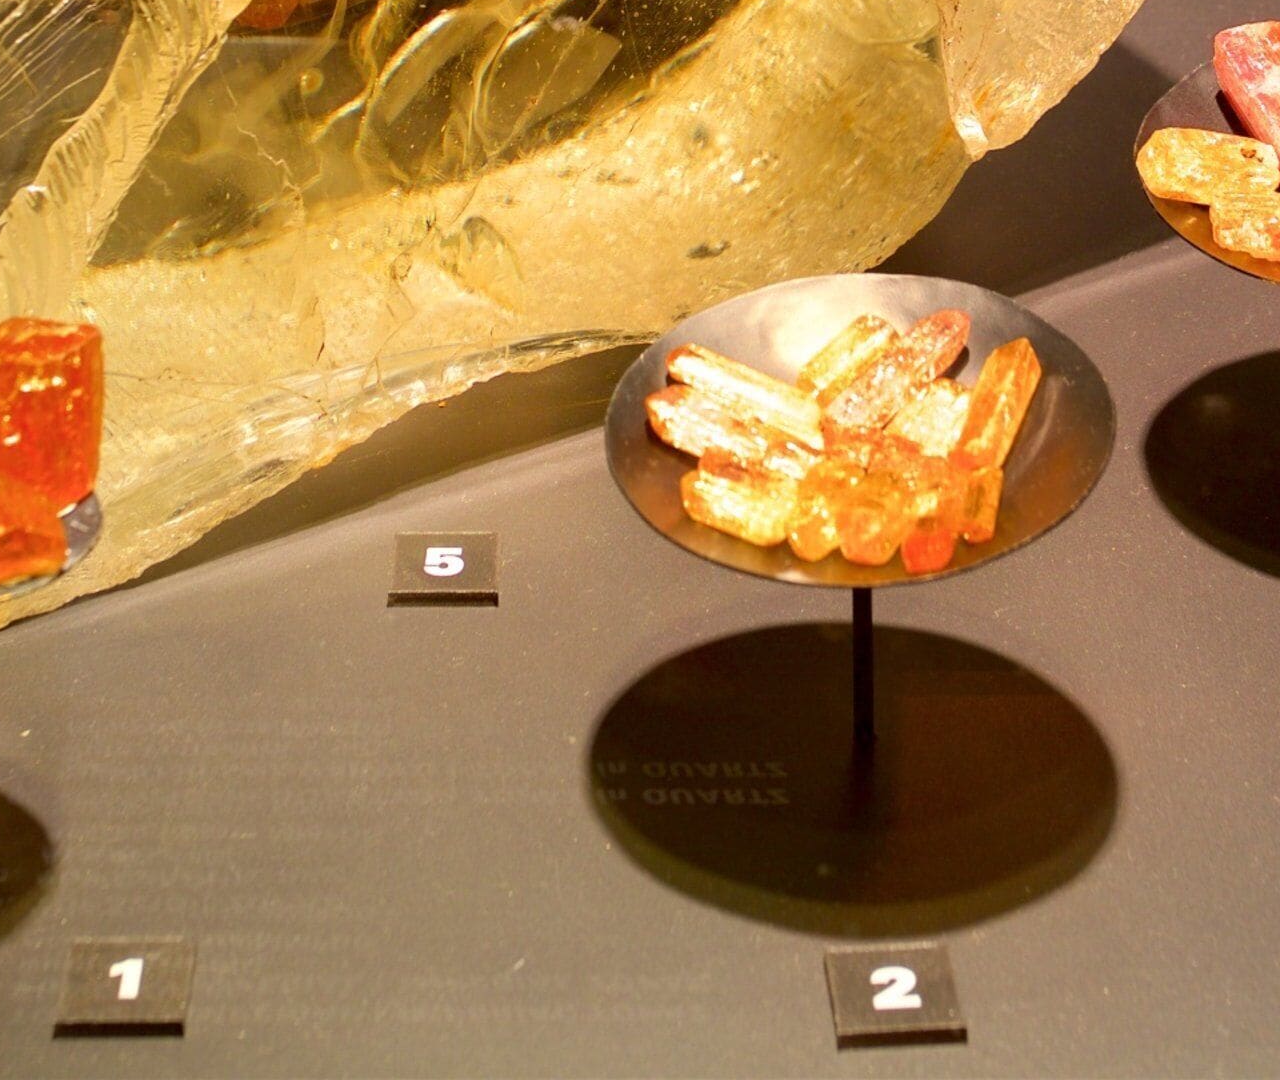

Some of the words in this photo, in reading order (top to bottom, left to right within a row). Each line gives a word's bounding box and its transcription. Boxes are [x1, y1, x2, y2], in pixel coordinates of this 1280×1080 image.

[422, 547, 465, 578] 5
[107, 957, 145, 1002] 1
[868, 965, 923, 1011] 2
